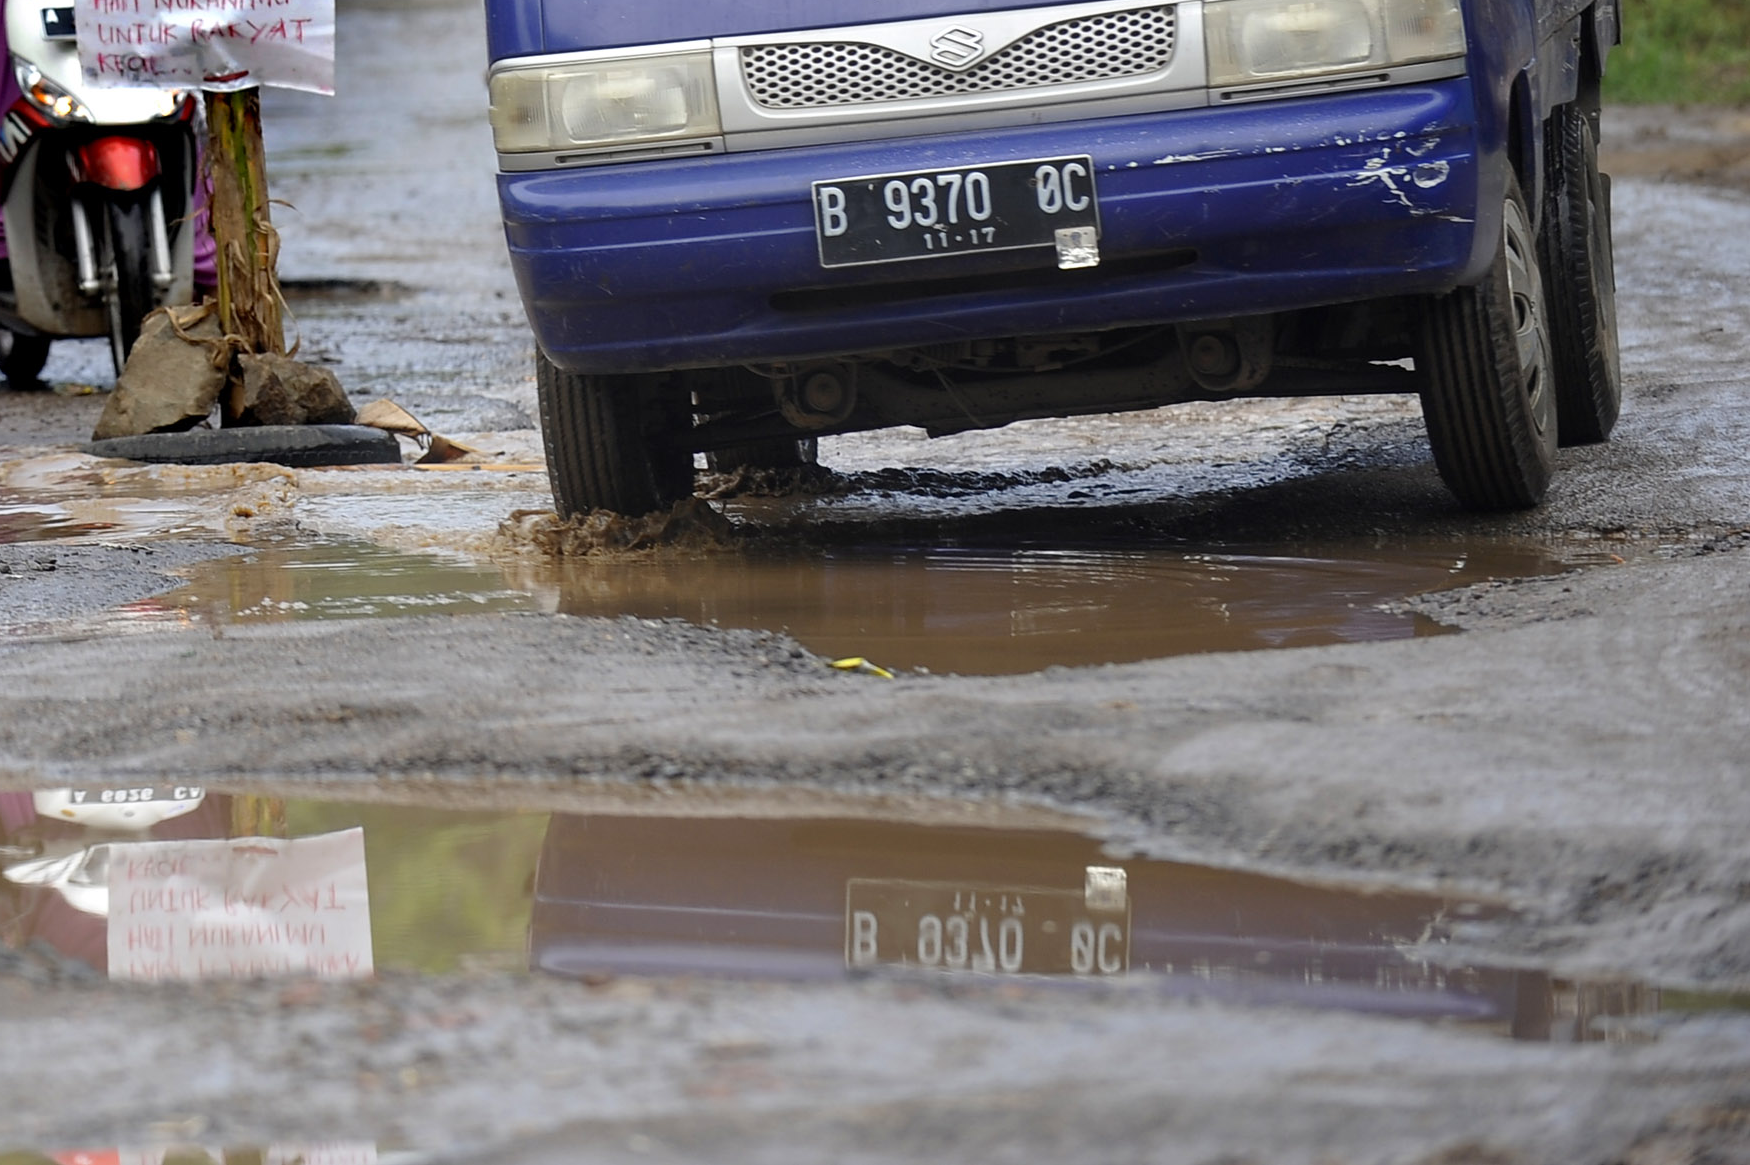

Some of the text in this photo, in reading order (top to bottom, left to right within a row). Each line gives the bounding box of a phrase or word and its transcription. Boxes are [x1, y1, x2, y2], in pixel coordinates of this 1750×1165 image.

[45, 8, 59, 24] A
[98, 18, 312, 46] UNTUK RAKYAT
[820, 187, 848, 237] B
[884, 172, 992, 229] 9370
